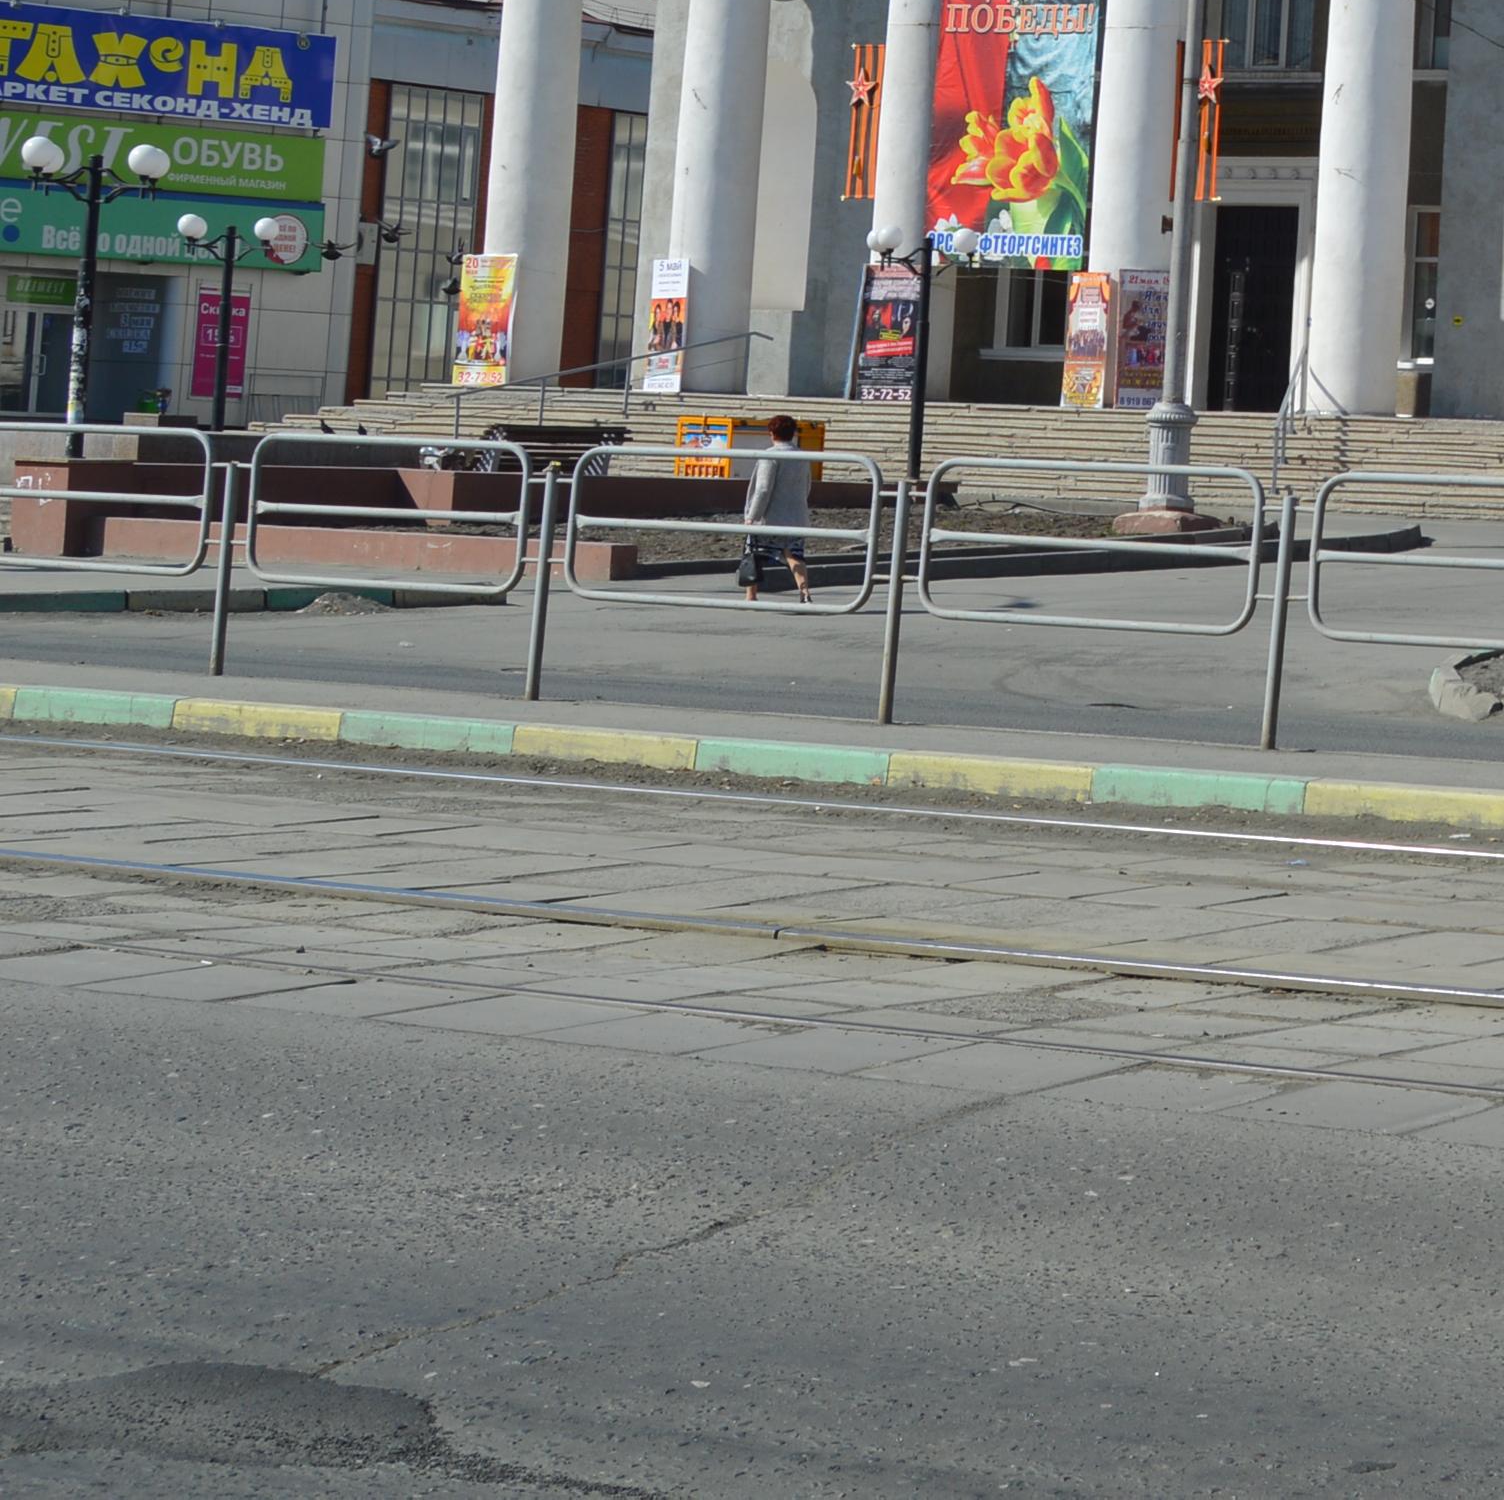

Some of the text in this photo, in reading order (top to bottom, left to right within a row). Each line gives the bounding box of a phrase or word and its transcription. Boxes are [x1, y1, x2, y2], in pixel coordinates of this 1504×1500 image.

[945, 3, 1095, 40] ПОБЕДЫ!
[95, 90, 313, 127] СЕКОНД-ХЕНД
[172, 136, 285, 173] ОБУВЬ
[167, 171, 287, 191] ФИРМЕННЫЙ МАГАЗИН
[42, 226, 81, 250] Всё
[114, 232, 180, 257] одной
[929, 231, 1082, 256] РСФТЕОРГСИНТЕЗ
[465, 258, 479, 268] 20
[659, 261, 665, 272] 5
[201, 302, 246, 317] Скка
[458, 371, 503, 382] 32-72-52
[860, 388, 912, 400] 32-72-52
